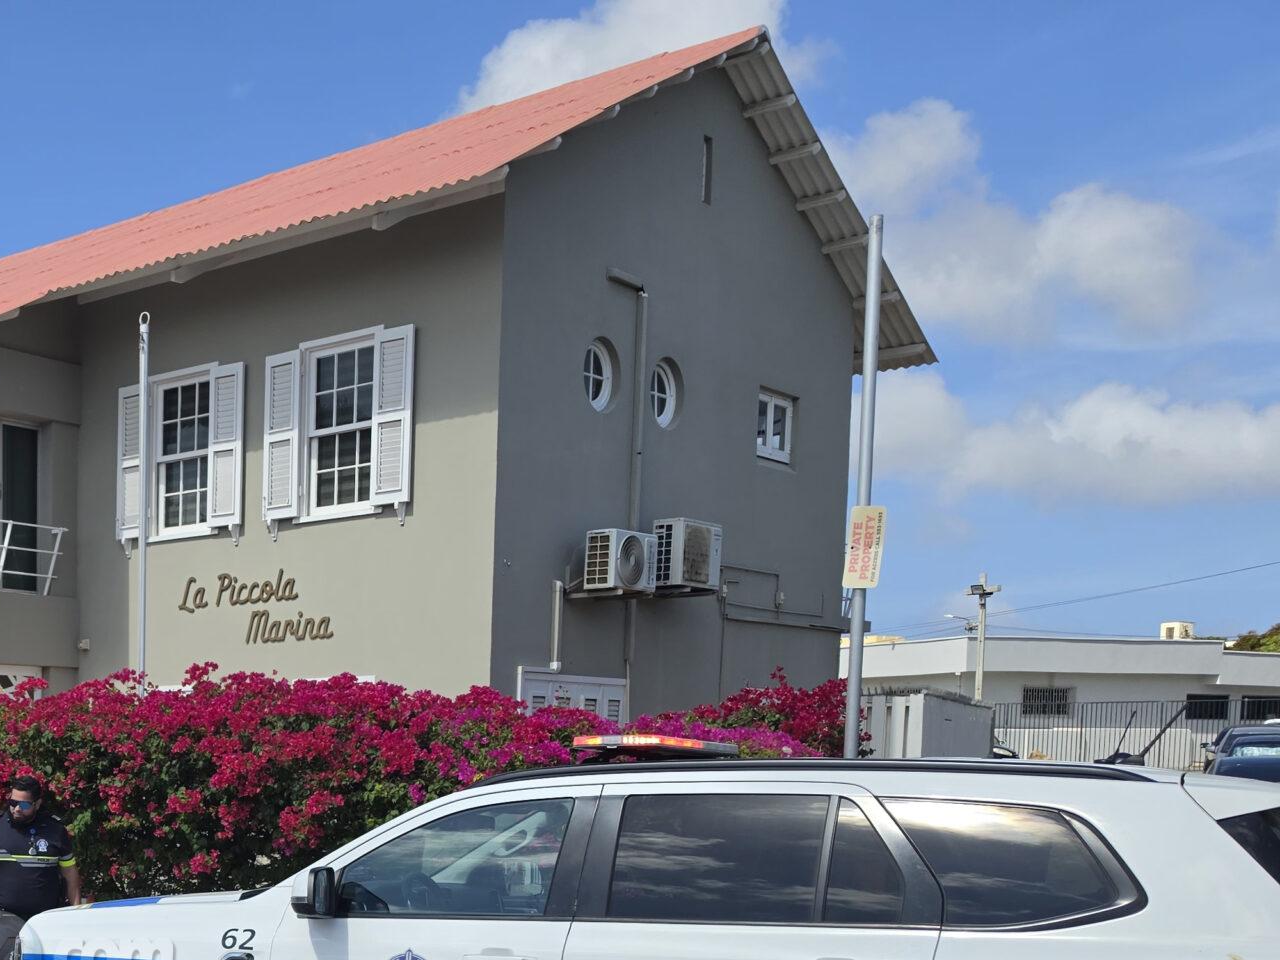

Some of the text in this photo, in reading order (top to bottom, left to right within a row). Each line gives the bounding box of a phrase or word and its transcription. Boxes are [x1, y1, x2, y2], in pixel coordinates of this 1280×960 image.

[848, 522, 863, 573] PRIVATE
[859, 515, 876, 580] PROPERTY
[178, 568, 299, 613] La Piccola
[246, 609, 334, 645] Marina
[221, 928, 256, 950] 62
